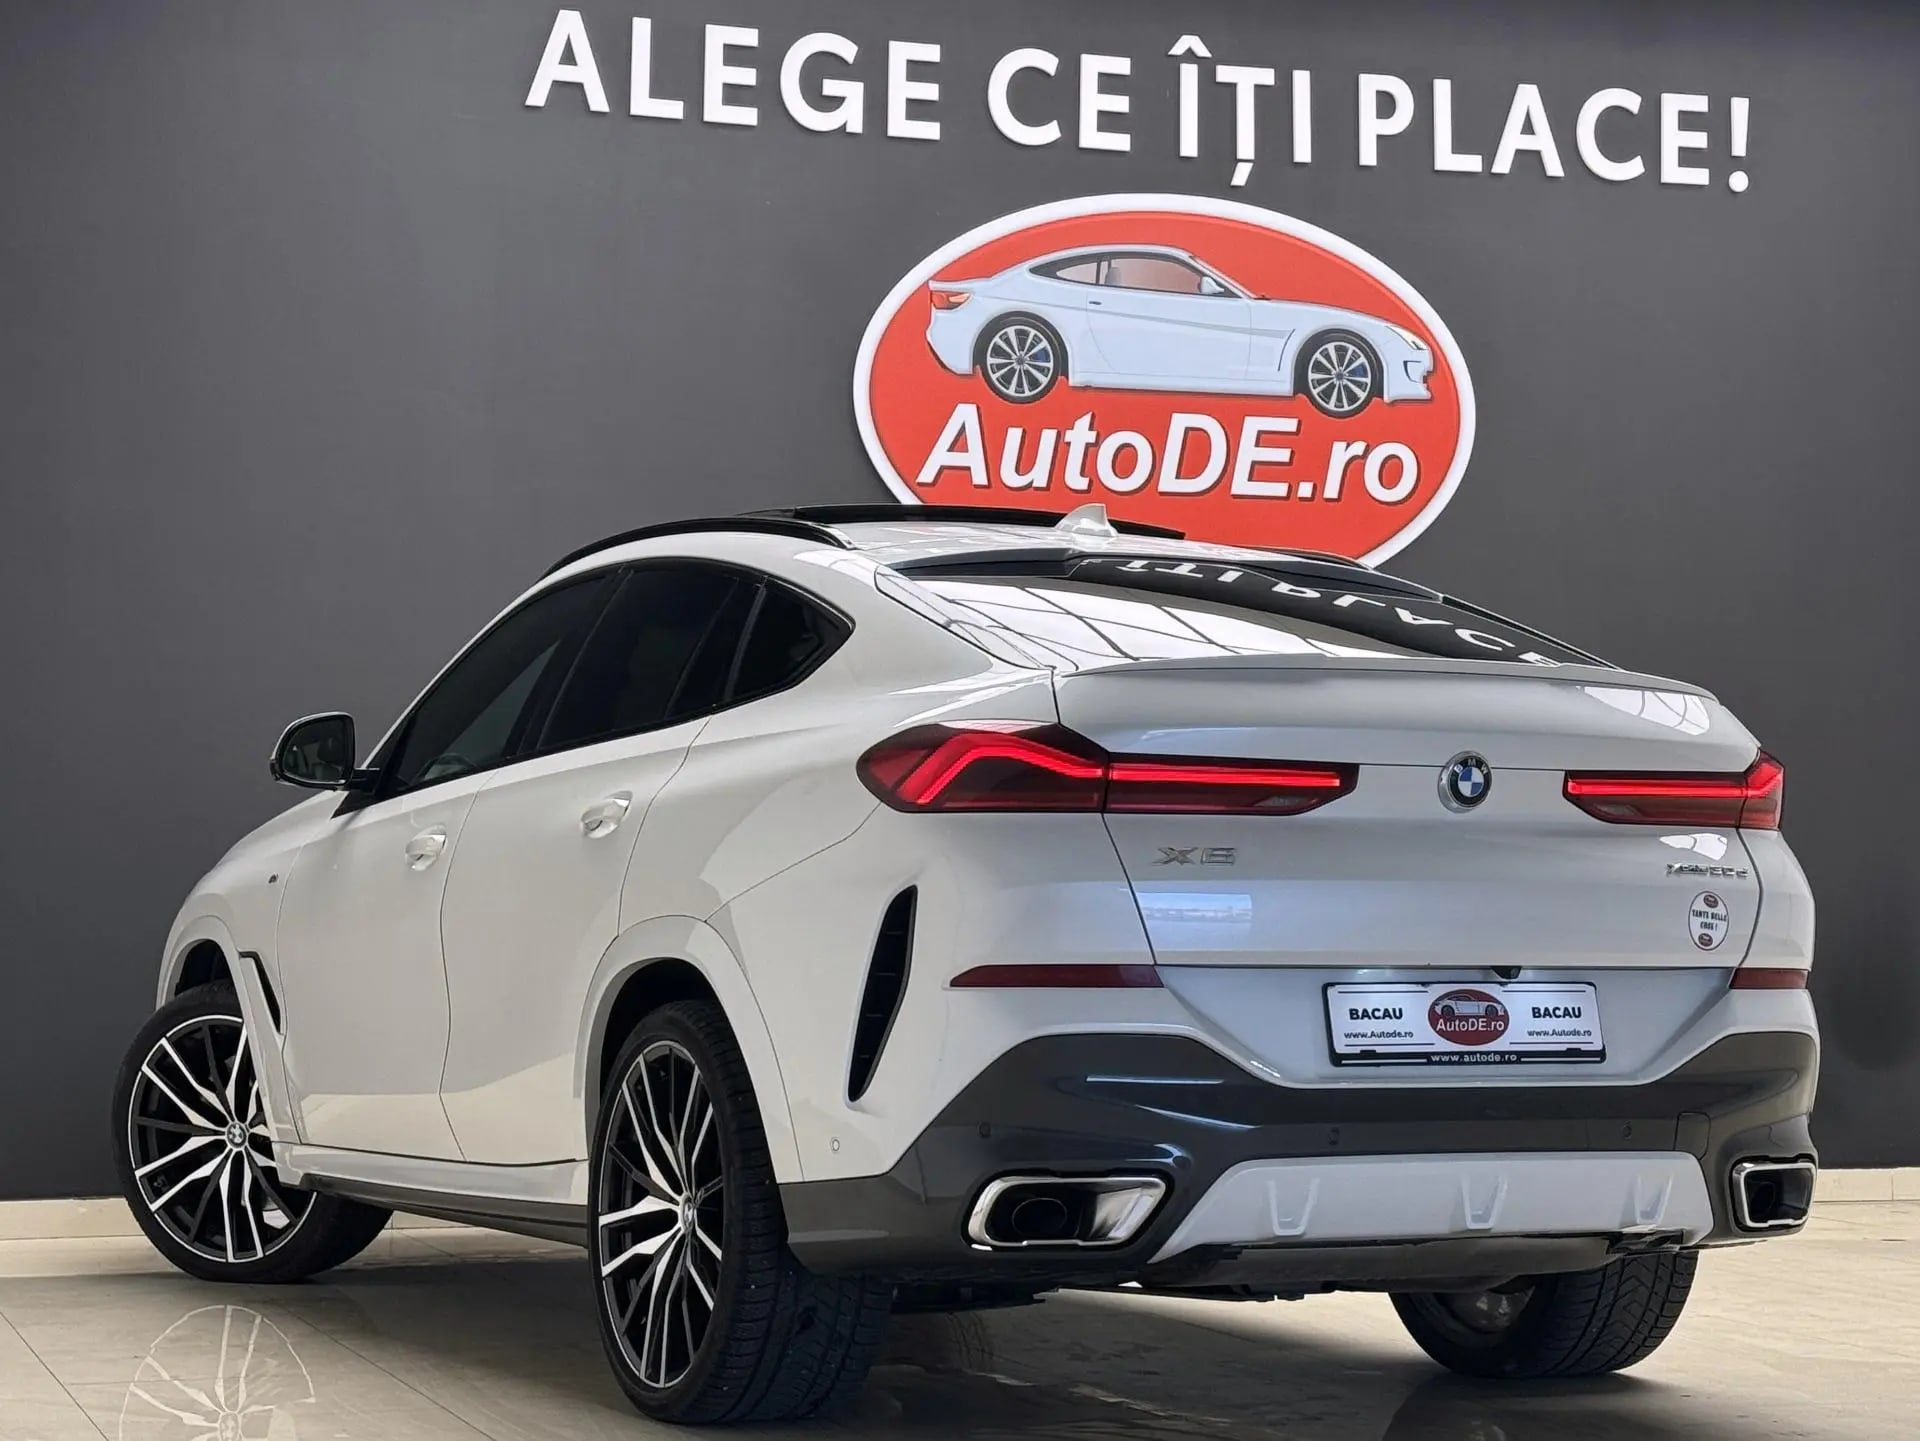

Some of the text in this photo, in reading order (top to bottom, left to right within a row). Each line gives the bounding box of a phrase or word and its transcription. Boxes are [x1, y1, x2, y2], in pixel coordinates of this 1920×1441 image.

[525, 9, 1751, 193] ALEGE CE ÎȚI PLACE!
[916, 402, 1420, 504] AutoDE.ro
[1154, 846, 1236, 866] X6
[1349, 1007, 1403, 1021] BACAU
[1531, 1006, 1582, 1019] BACAU
[1436, 1018, 1505, 1032] AutoDE.ro
[1344, 1030, 1414, 1039] www.Autode.ro
[1527, 1028, 1592, 1038] www.Autode.ro
[1431, 1053, 1518, 1063] www.autode.ro
